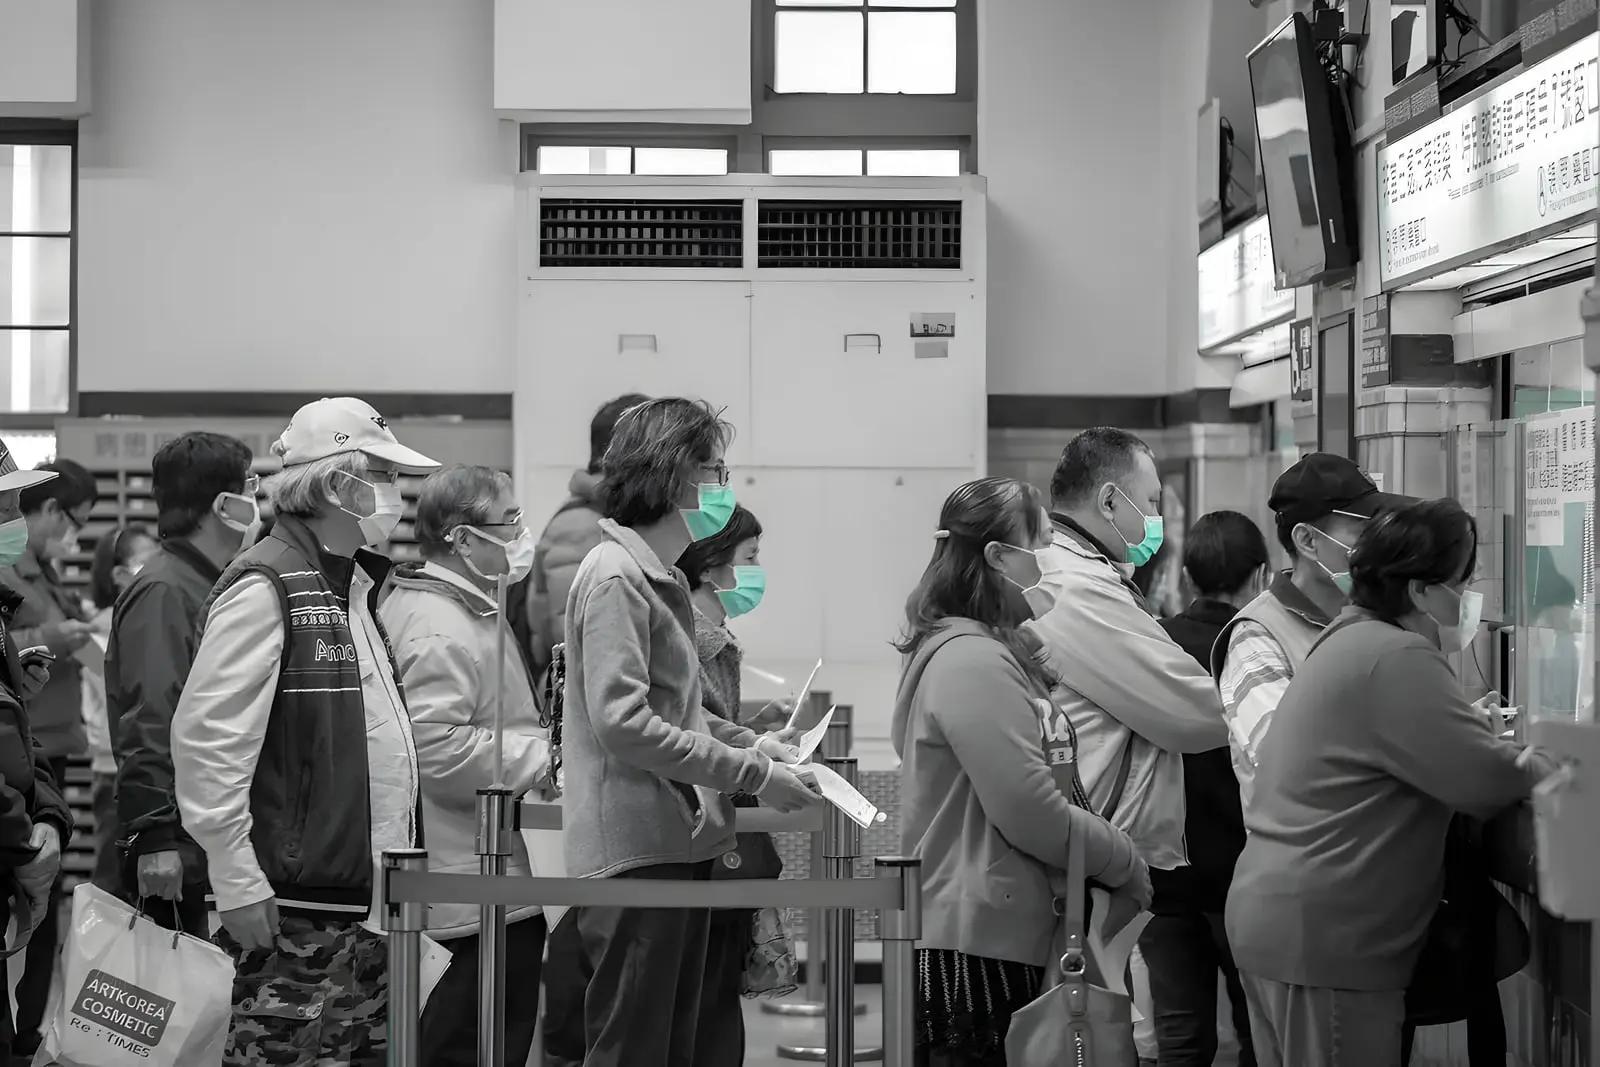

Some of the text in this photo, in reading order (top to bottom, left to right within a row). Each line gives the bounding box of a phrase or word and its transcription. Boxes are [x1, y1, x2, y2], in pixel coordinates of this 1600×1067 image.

[315, 638, 356, 661] Amo
[86, 978, 165, 1021] ARTKOREA
[81, 997, 159, 1039] COSMETIC
[107, 1031, 151, 1058] TIMES
